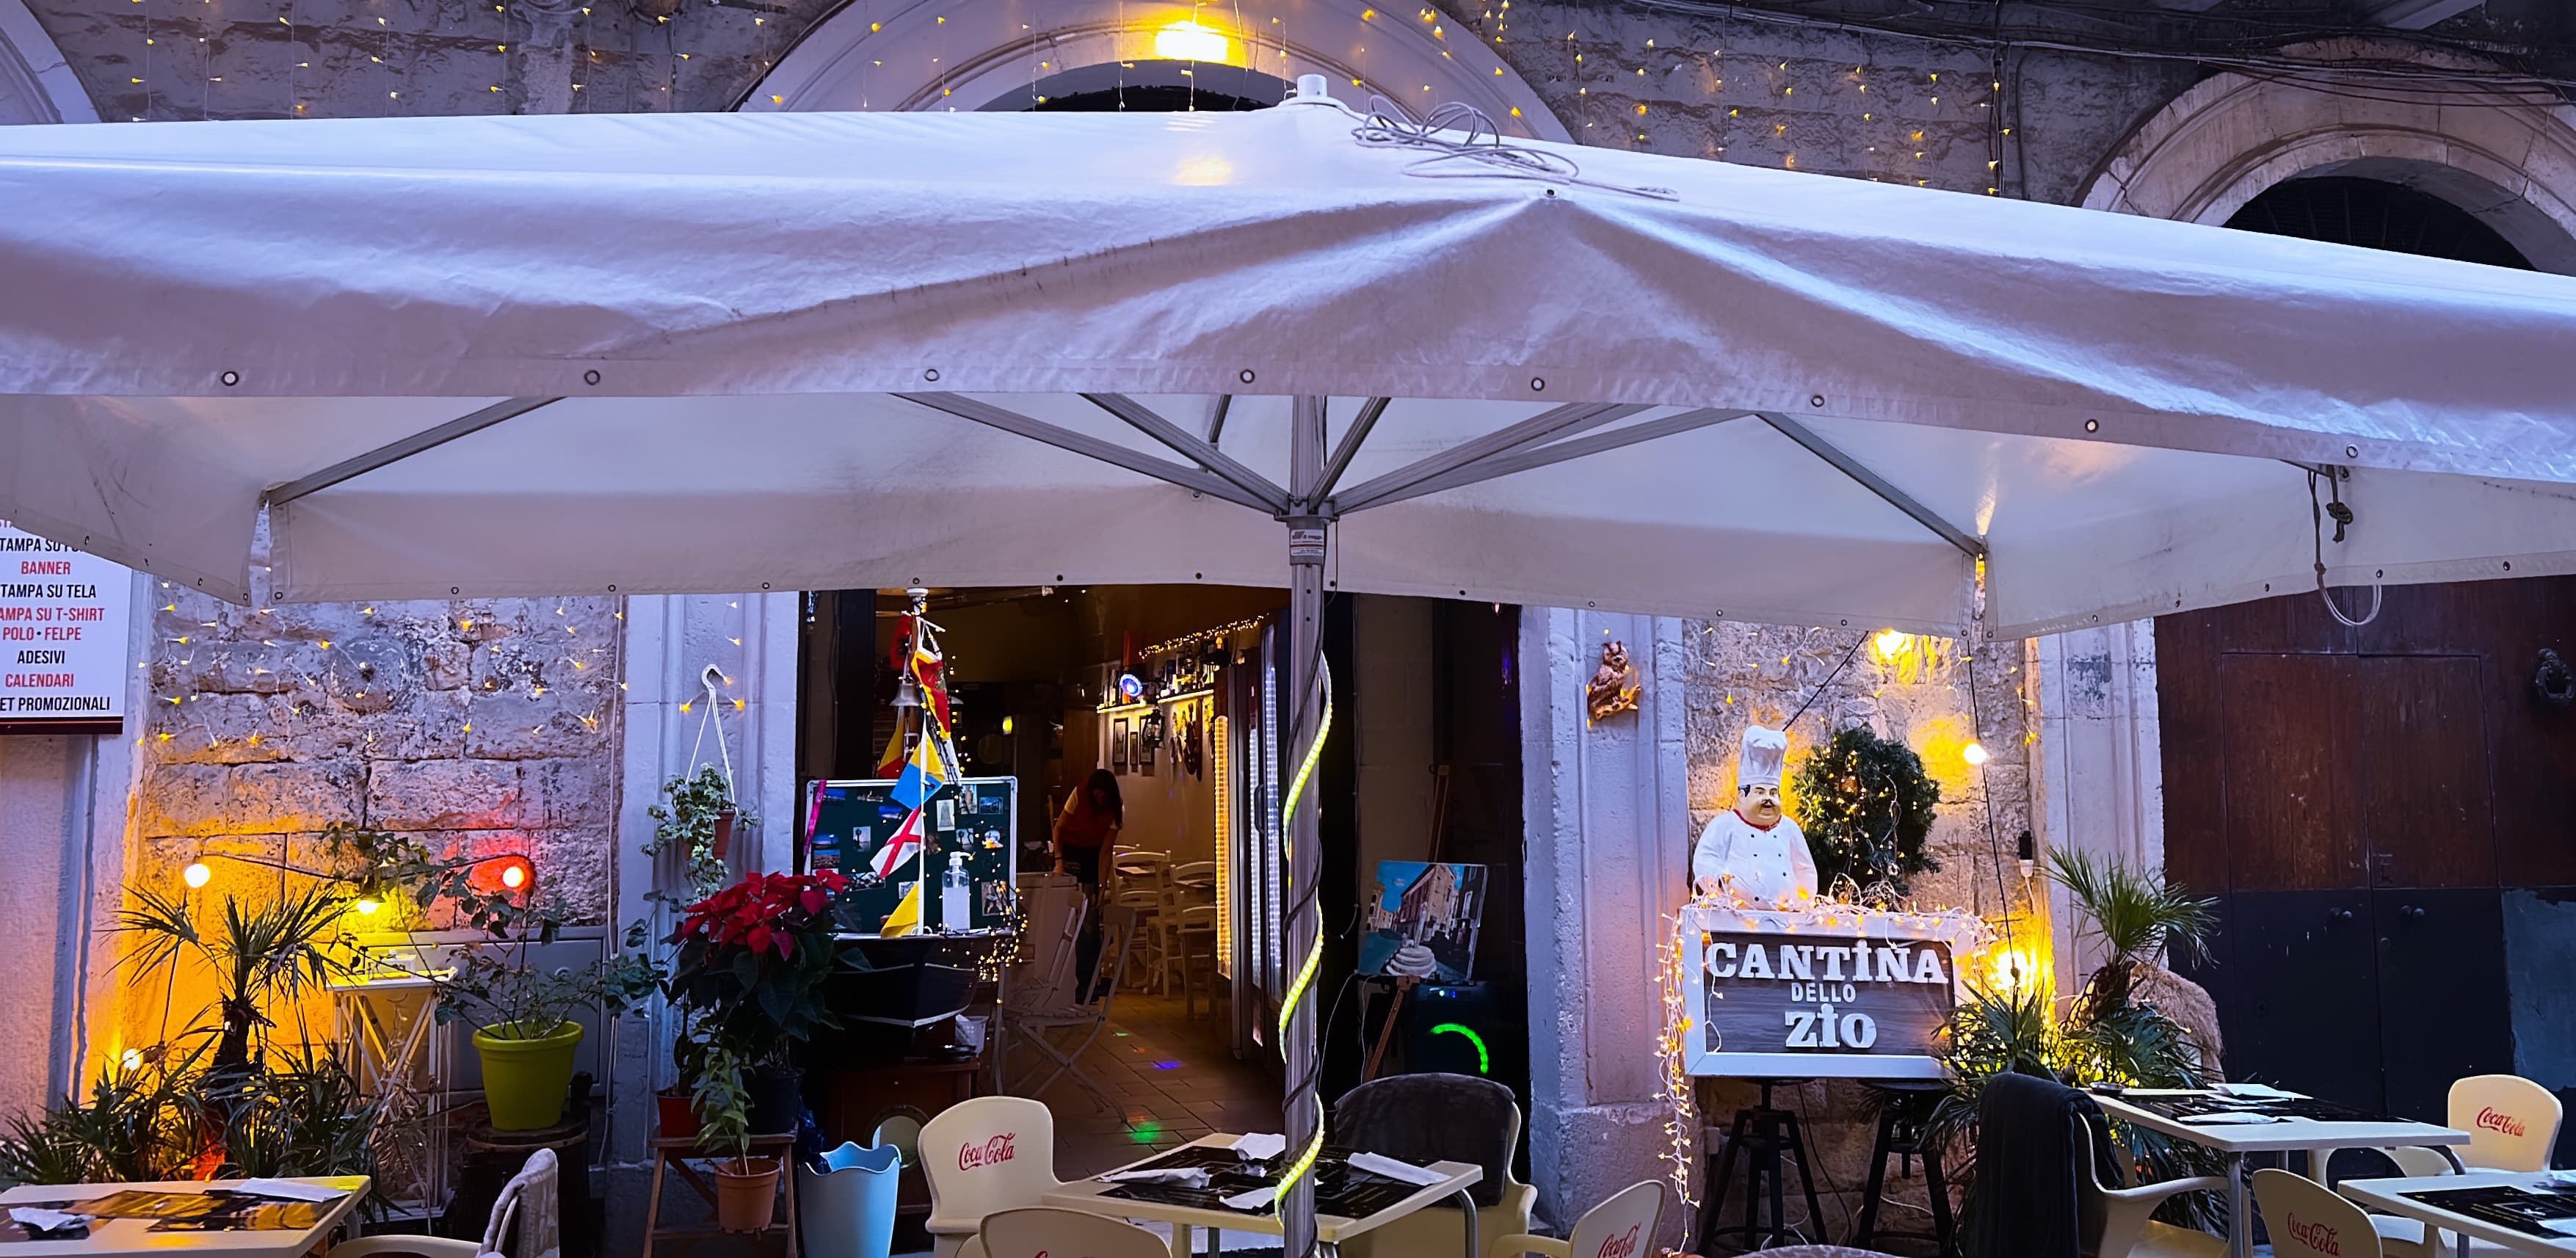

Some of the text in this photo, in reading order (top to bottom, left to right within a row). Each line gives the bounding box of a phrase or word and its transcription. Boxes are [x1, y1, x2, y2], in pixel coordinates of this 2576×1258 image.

[0, 538, 41, 551] TAMPA
[21, 561, 70, 575] BANNER
[0, 584, 96, 597] TAMPA SU TELA
[0, 608, 105, 621] AMPA SU T-SHIRT
[3, 628, 81, 640] POLO FELPE
[17, 650, 65, 663] ADESIVI
[5, 674, 74, 687] CALENDARI
[18, 697, 110, 710] PROMOZIONALI
[1791, 982, 1856, 1003] DELLO
